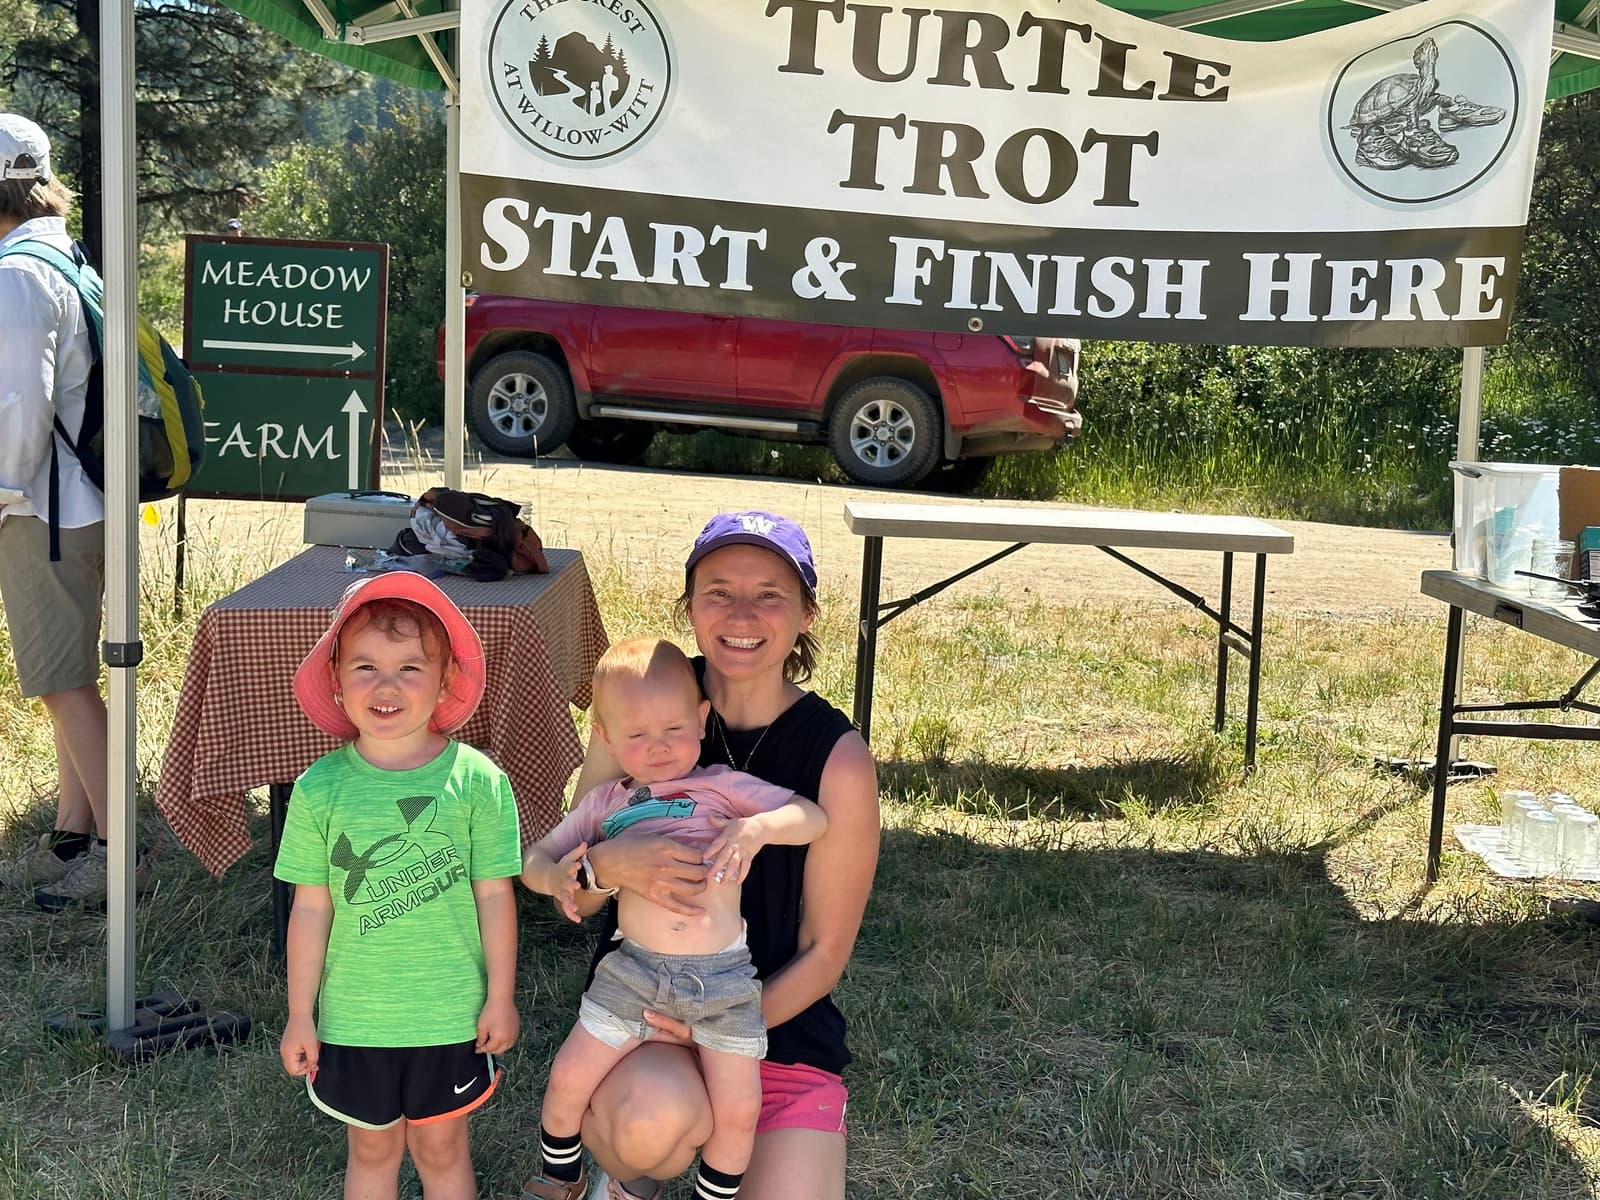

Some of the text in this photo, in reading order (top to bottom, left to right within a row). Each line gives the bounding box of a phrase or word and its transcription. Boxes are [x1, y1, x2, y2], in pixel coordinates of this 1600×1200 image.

[765, 0, 1232, 102] TURTLE
[503, 60, 655, 146] AT WILLOW-WITT
[826, 107, 1160, 208] TROT
[201, 260, 371, 292] MEADOW
[479, 196, 1506, 323] START & FINISH HERE
[222, 298, 345, 329] HOUSE
[359, 863, 469, 936] ARMOUR
[366, 845, 461, 903] UNDER
